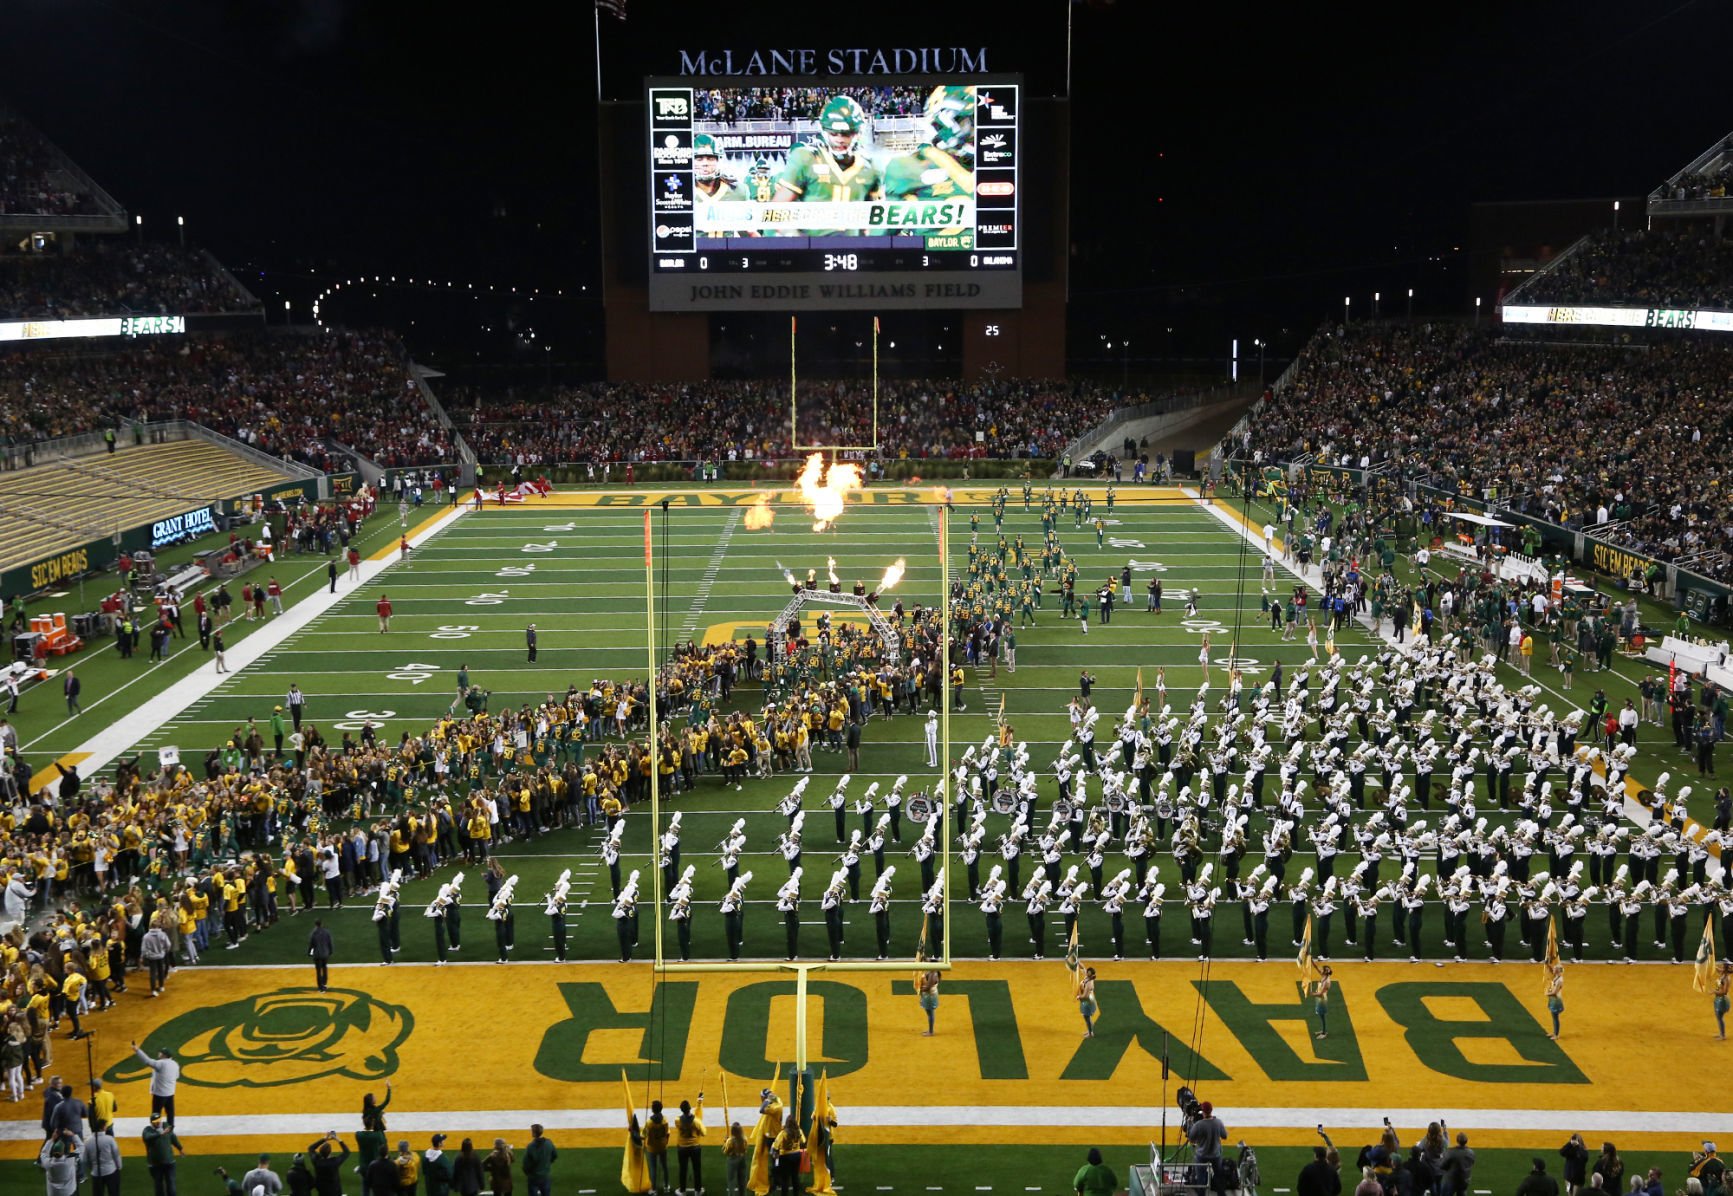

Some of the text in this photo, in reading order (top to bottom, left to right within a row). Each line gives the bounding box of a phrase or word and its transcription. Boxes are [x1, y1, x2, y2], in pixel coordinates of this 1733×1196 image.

[679, 47, 989, 75] McLANE STADIUM
[868, 203, 965, 226] BEARS!
[927, 236, 959, 248] BAYLOR
[699, 257, 708, 269] 0
[742, 257, 749, 268] 3
[824, 253, 858, 270] 3:48
[922, 255, 929, 266] 3
[970, 255, 978, 267] 0
[690, 282, 981, 302] JOHN EDDIE WILLIAMS FIELD
[1645, 308, 1698, 329] BEARS!
[985, 325, 1000, 336] 25
[594, 492, 921, 505] BAYLR
[152, 507, 211, 539] GRANT HOTEL
[429, 624, 481, 640] 50
[1179, 619, 1230, 635] 50
[385, 663, 442, 680] 40
[332, 709, 398, 731] 30
[532, 979, 1593, 1084] BAYLOR
